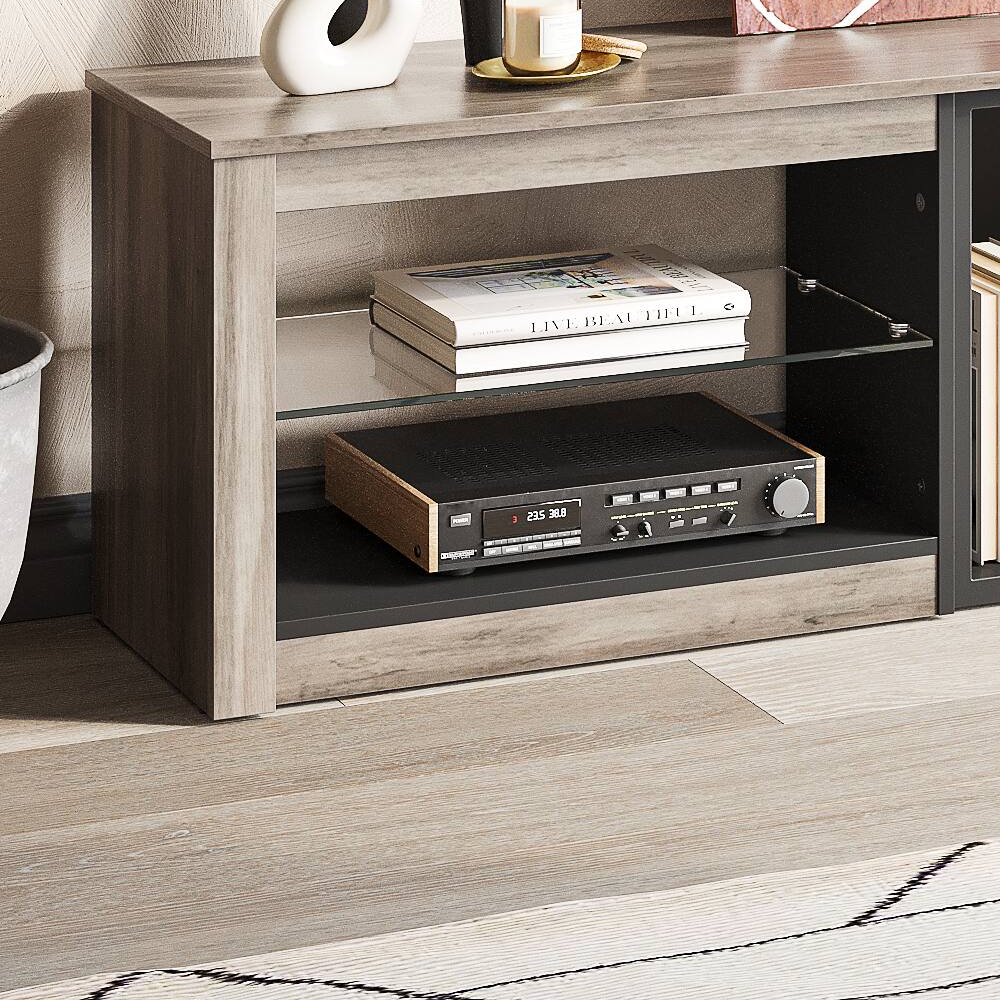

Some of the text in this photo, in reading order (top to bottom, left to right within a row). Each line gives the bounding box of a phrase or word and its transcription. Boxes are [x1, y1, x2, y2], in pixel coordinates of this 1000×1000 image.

[530, 317, 578, 334] LIVE
[452, 517, 470, 525] POWER
[526, 509, 546, 522] 23.5
[548, 507, 567, 519] 38.8
